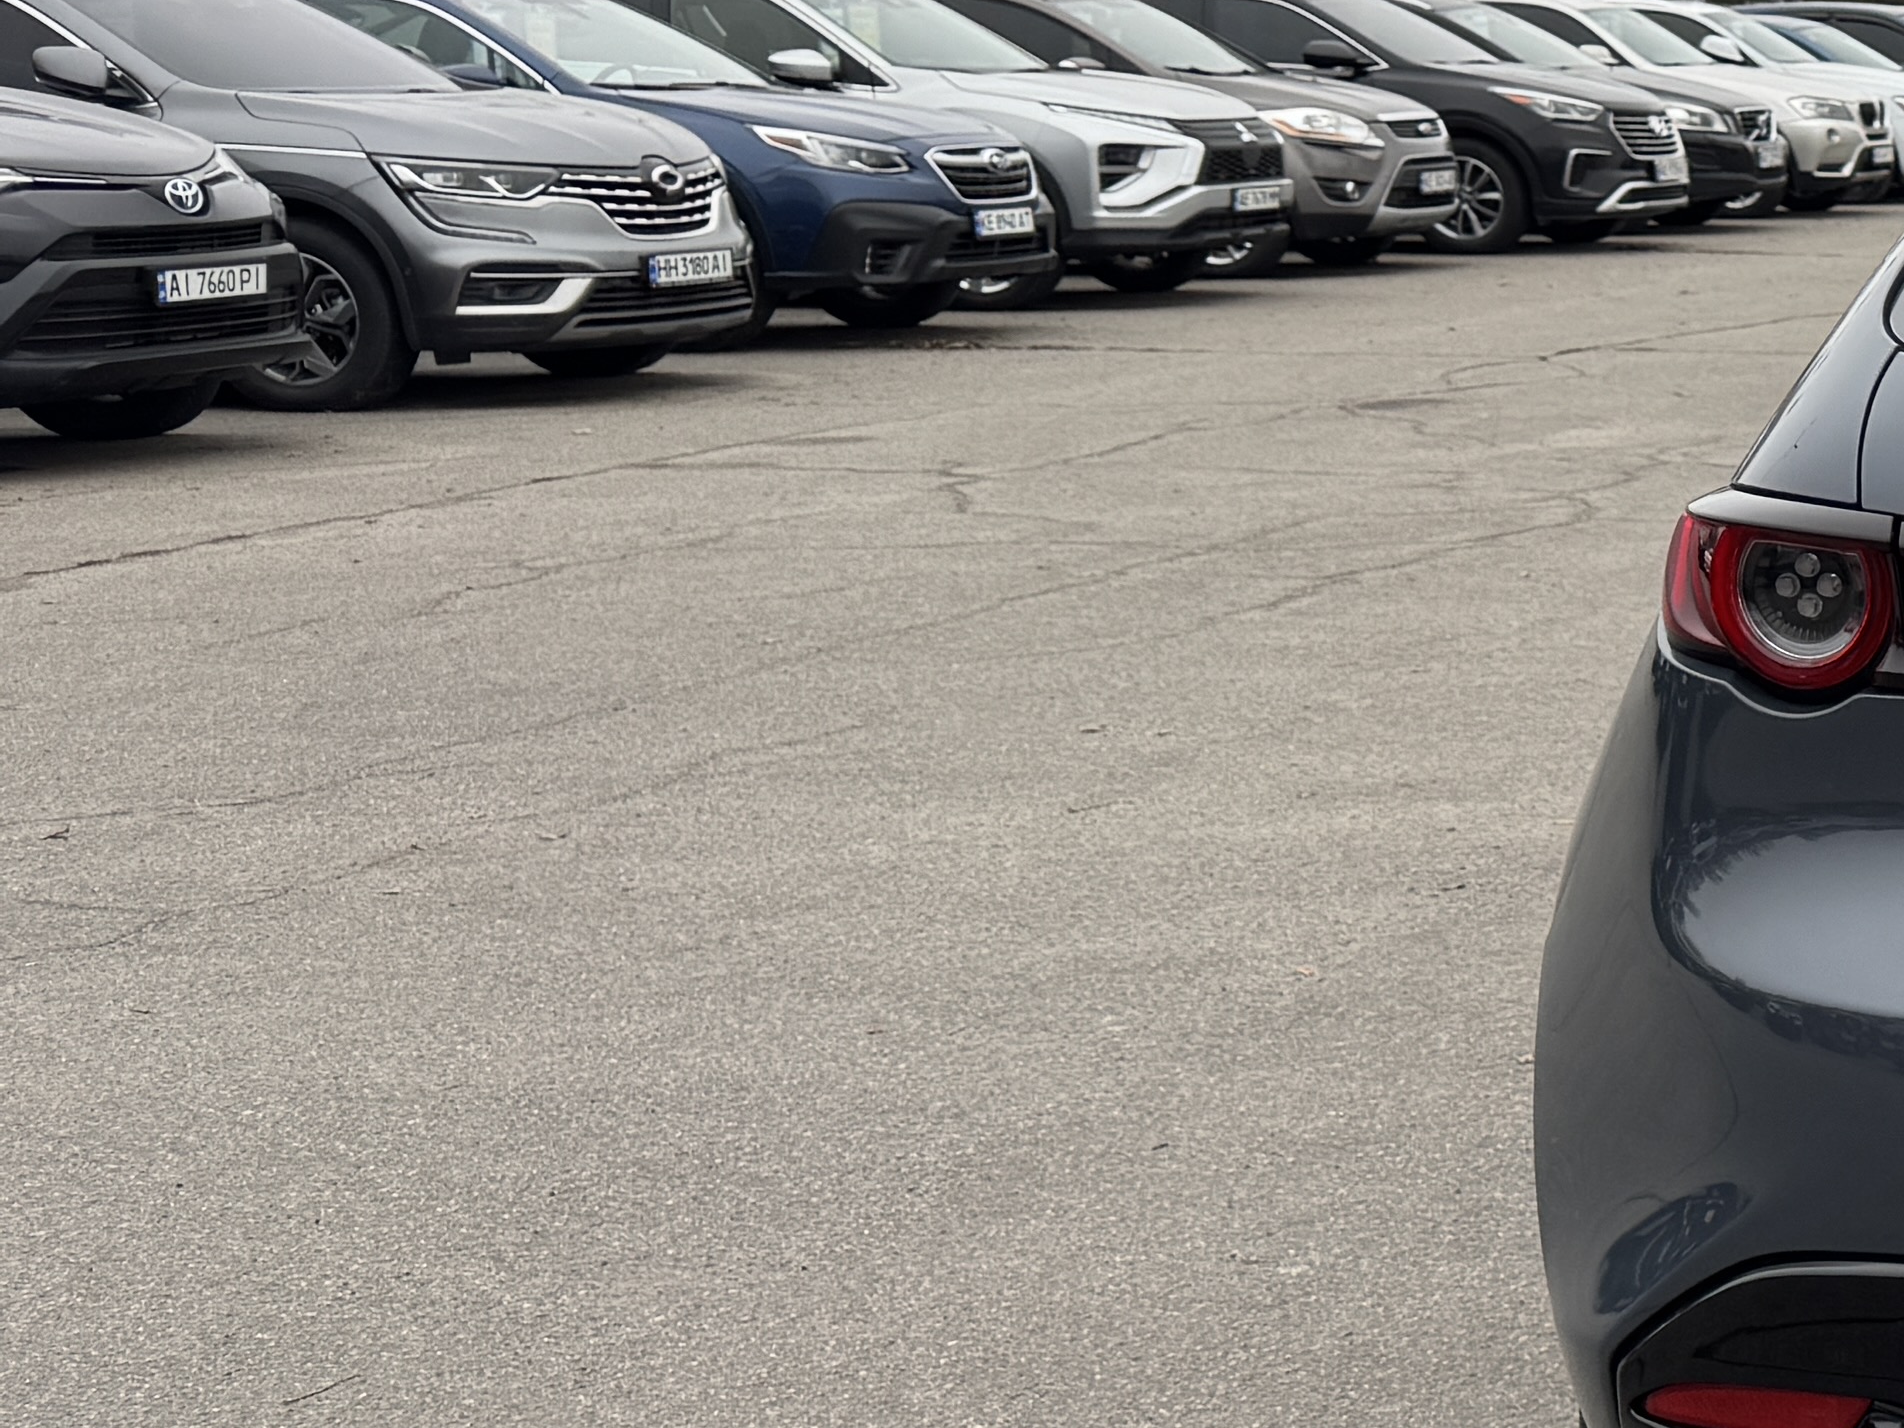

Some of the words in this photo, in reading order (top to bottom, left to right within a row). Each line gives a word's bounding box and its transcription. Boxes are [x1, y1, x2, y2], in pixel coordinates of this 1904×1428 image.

[658, 258, 679, 278] HH
[712, 253, 727, 274] AI
[169, 272, 189, 297] AI
[197, 270, 235, 294] 7660
[239, 266, 260, 291] PI
